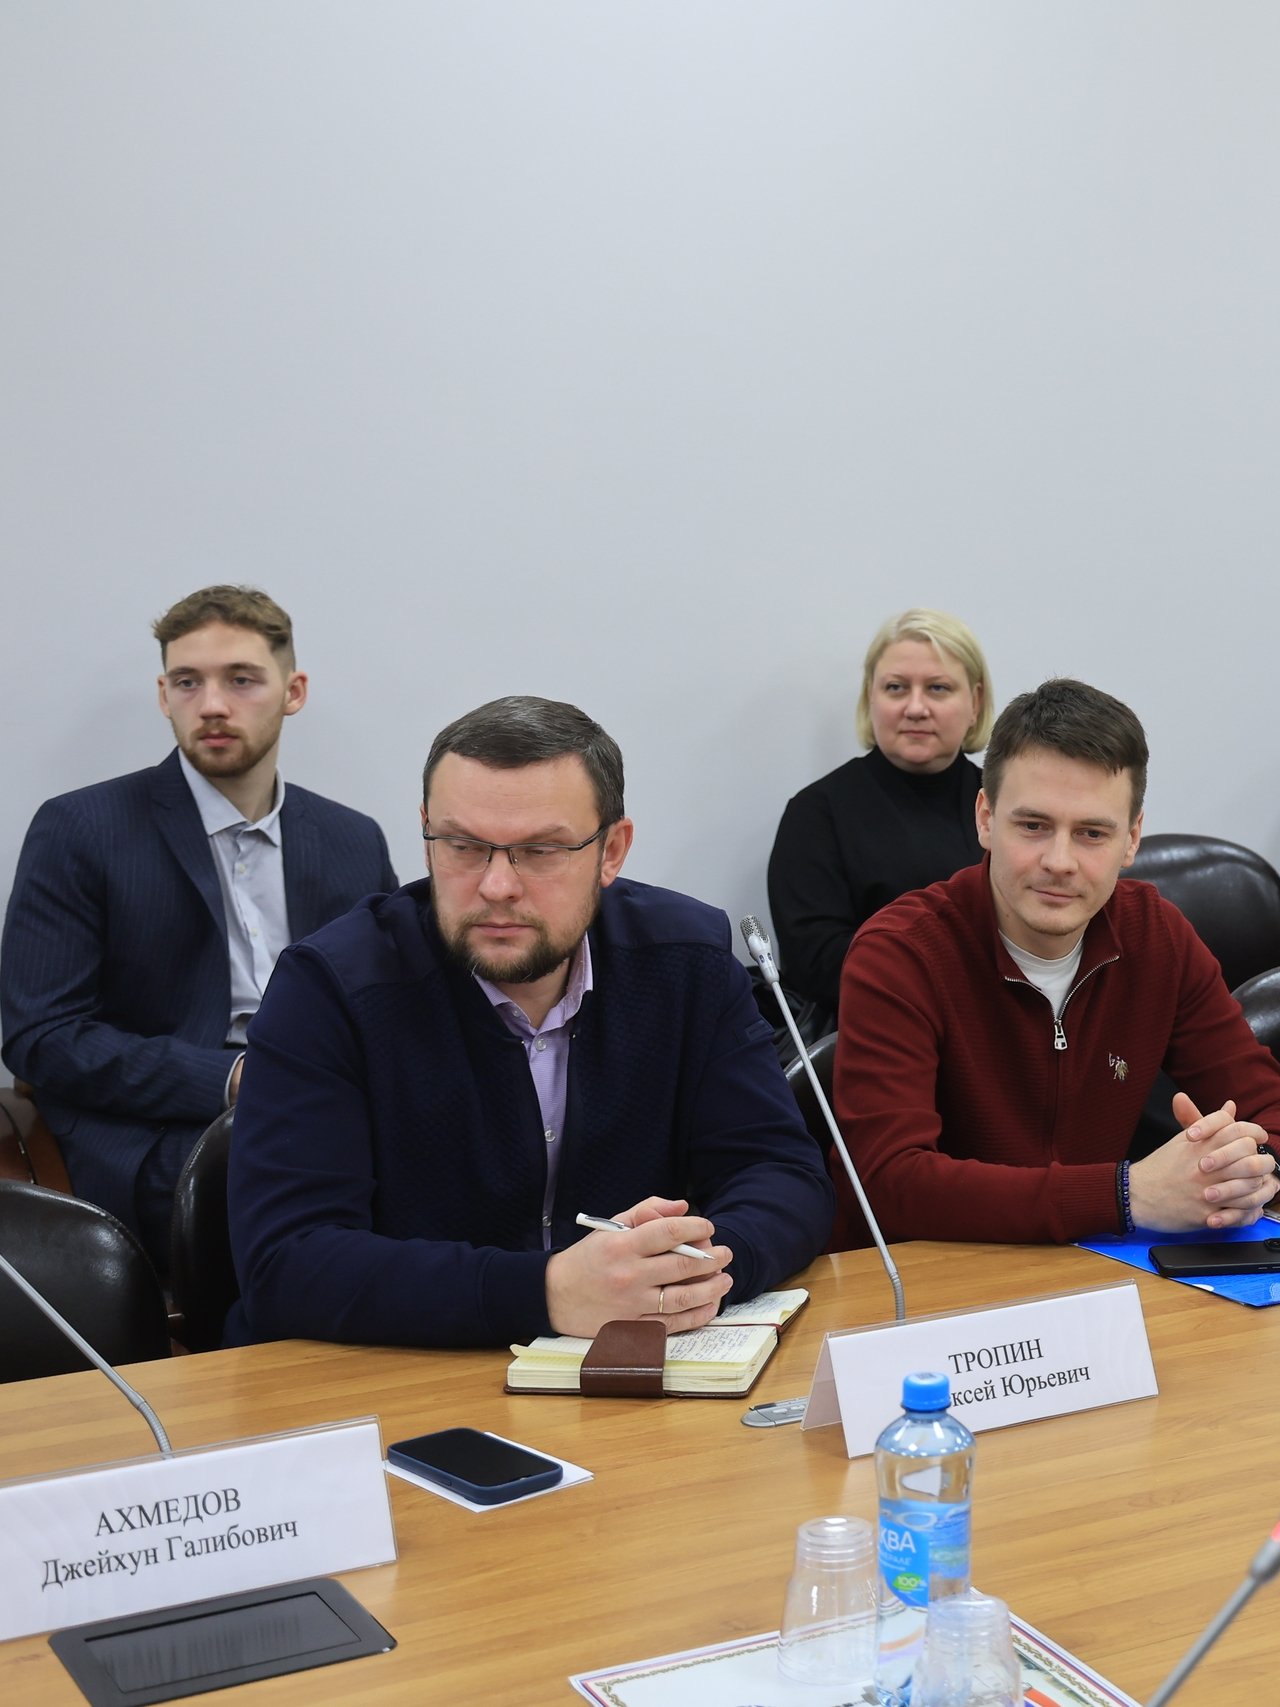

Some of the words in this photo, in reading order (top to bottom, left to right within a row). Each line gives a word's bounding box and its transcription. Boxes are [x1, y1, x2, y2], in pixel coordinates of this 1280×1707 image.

[948, 1338, 1044, 1375] ТРОПИН
[949, 1379, 997, 1408] ксей
[1001, 1366, 1091, 1398] Юрьевич
[95, 1487, 242, 1537] АХМЕДОВ
[41, 1544, 159, 1592] Джейхун
[165, 1520, 299, 1561] Галибович
[880, 1528, 917, 1554] КВА
